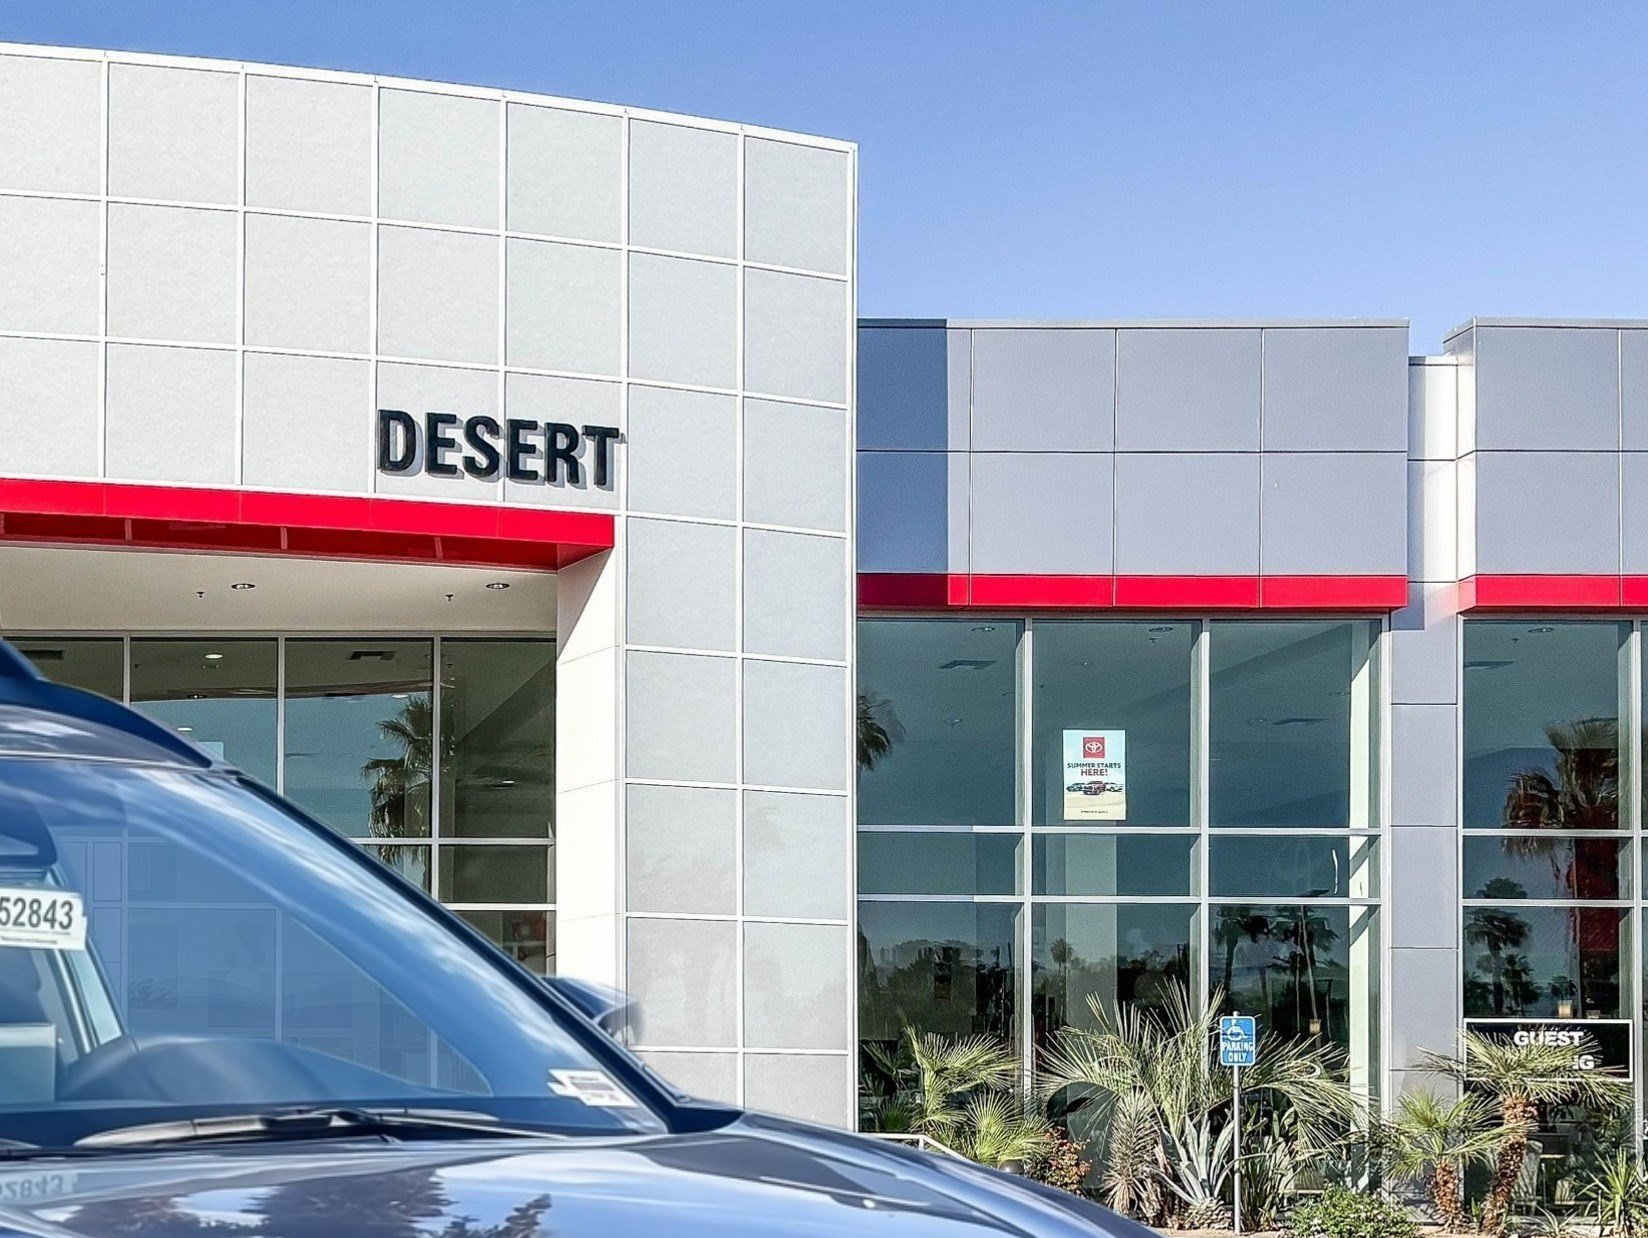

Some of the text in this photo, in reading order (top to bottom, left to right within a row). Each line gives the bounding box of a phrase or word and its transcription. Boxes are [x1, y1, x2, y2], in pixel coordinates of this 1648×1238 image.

[376, 408, 621, 486] DESERT
[1080, 768, 1108, 777] HERE!
[1513, 1031, 1584, 1047] GUEST
[1221, 1041, 1254, 1051] PARKING
[1228, 1051, 1248, 1062] ONLY
